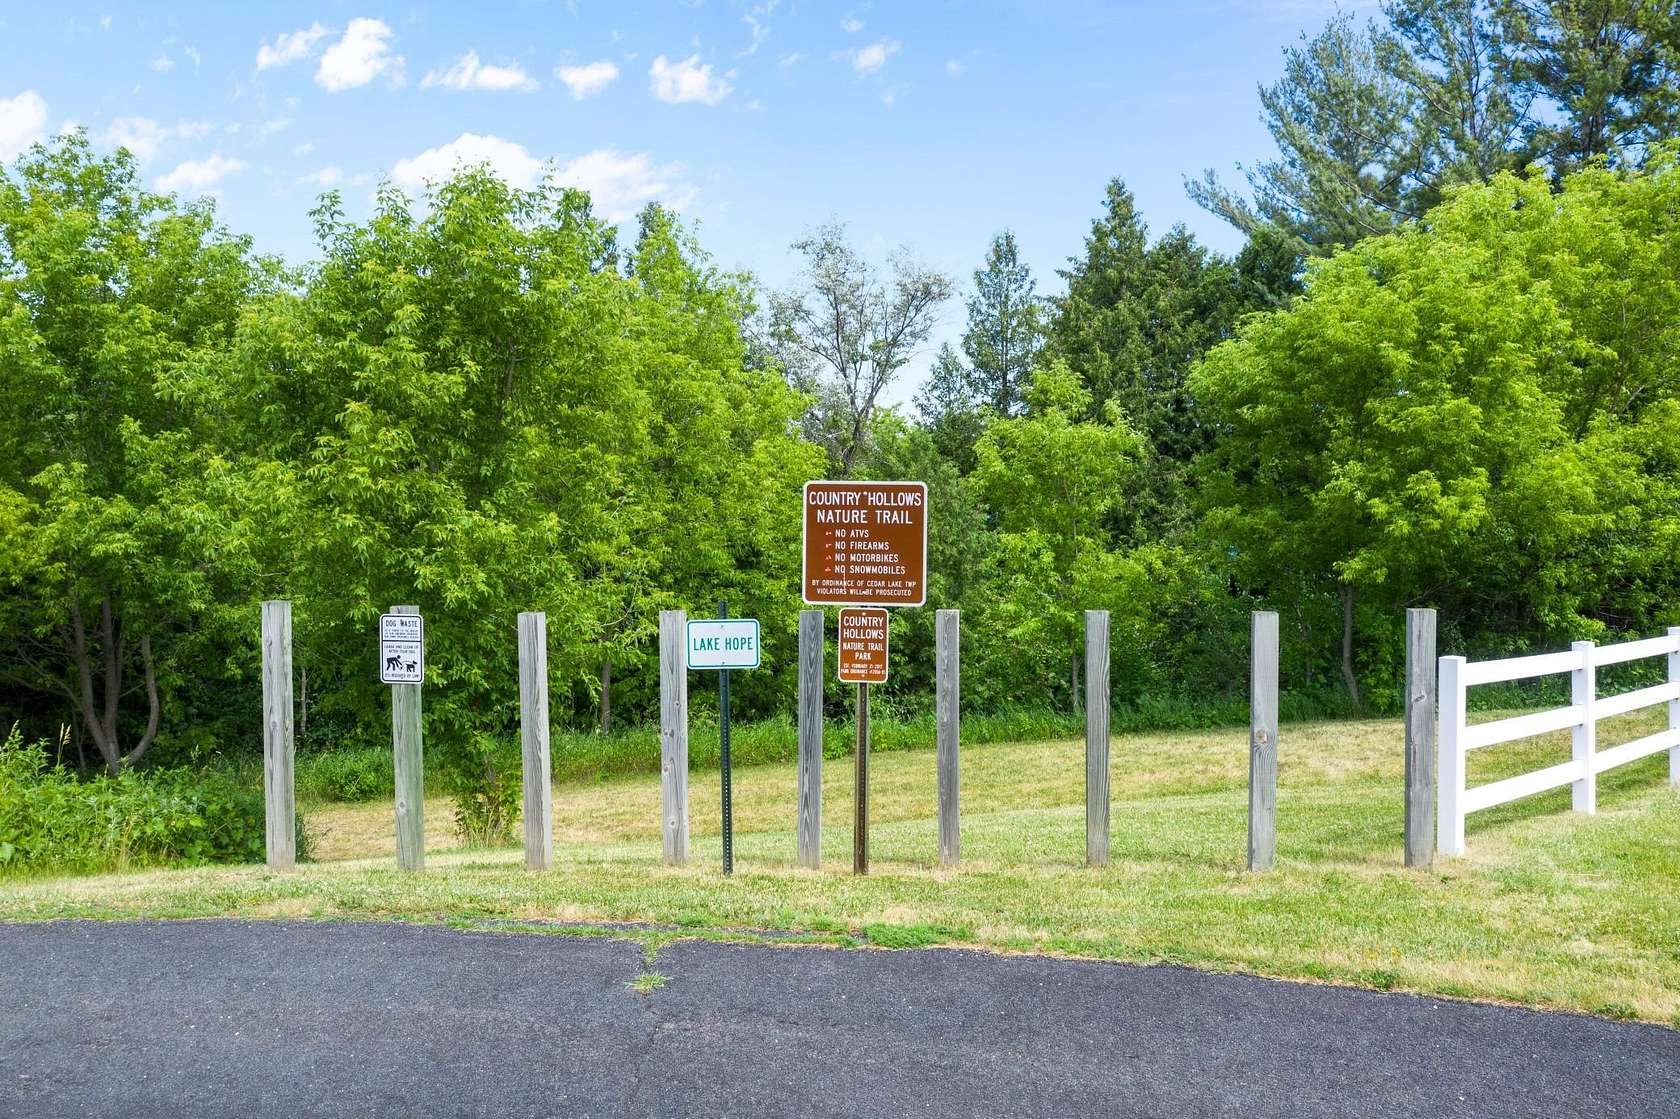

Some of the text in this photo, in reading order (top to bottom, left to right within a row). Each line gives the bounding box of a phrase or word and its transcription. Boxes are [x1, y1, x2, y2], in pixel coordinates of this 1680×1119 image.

[809, 491, 921, 506] COUNTRY HOLLOWS
[816, 510, 912, 524] NATURE TRAIL
[835, 529, 869, 538] NO ATVS
[835, 542, 890, 550] NO FIREARMS
[835, 553, 899, 562] NO MOTORBIKES
[834, 565, 906, 574] NO SNOWMOBILES
[400, 619, 418, 627] WASTE
[843, 616, 884, 626] COUNTRY
[843, 628, 884, 640] HOLLOWS
[694, 636, 753, 651] LAKE HOPE
[842, 642, 884, 651] NATURE TRAIL
[855, 652, 871, 660] PARK
